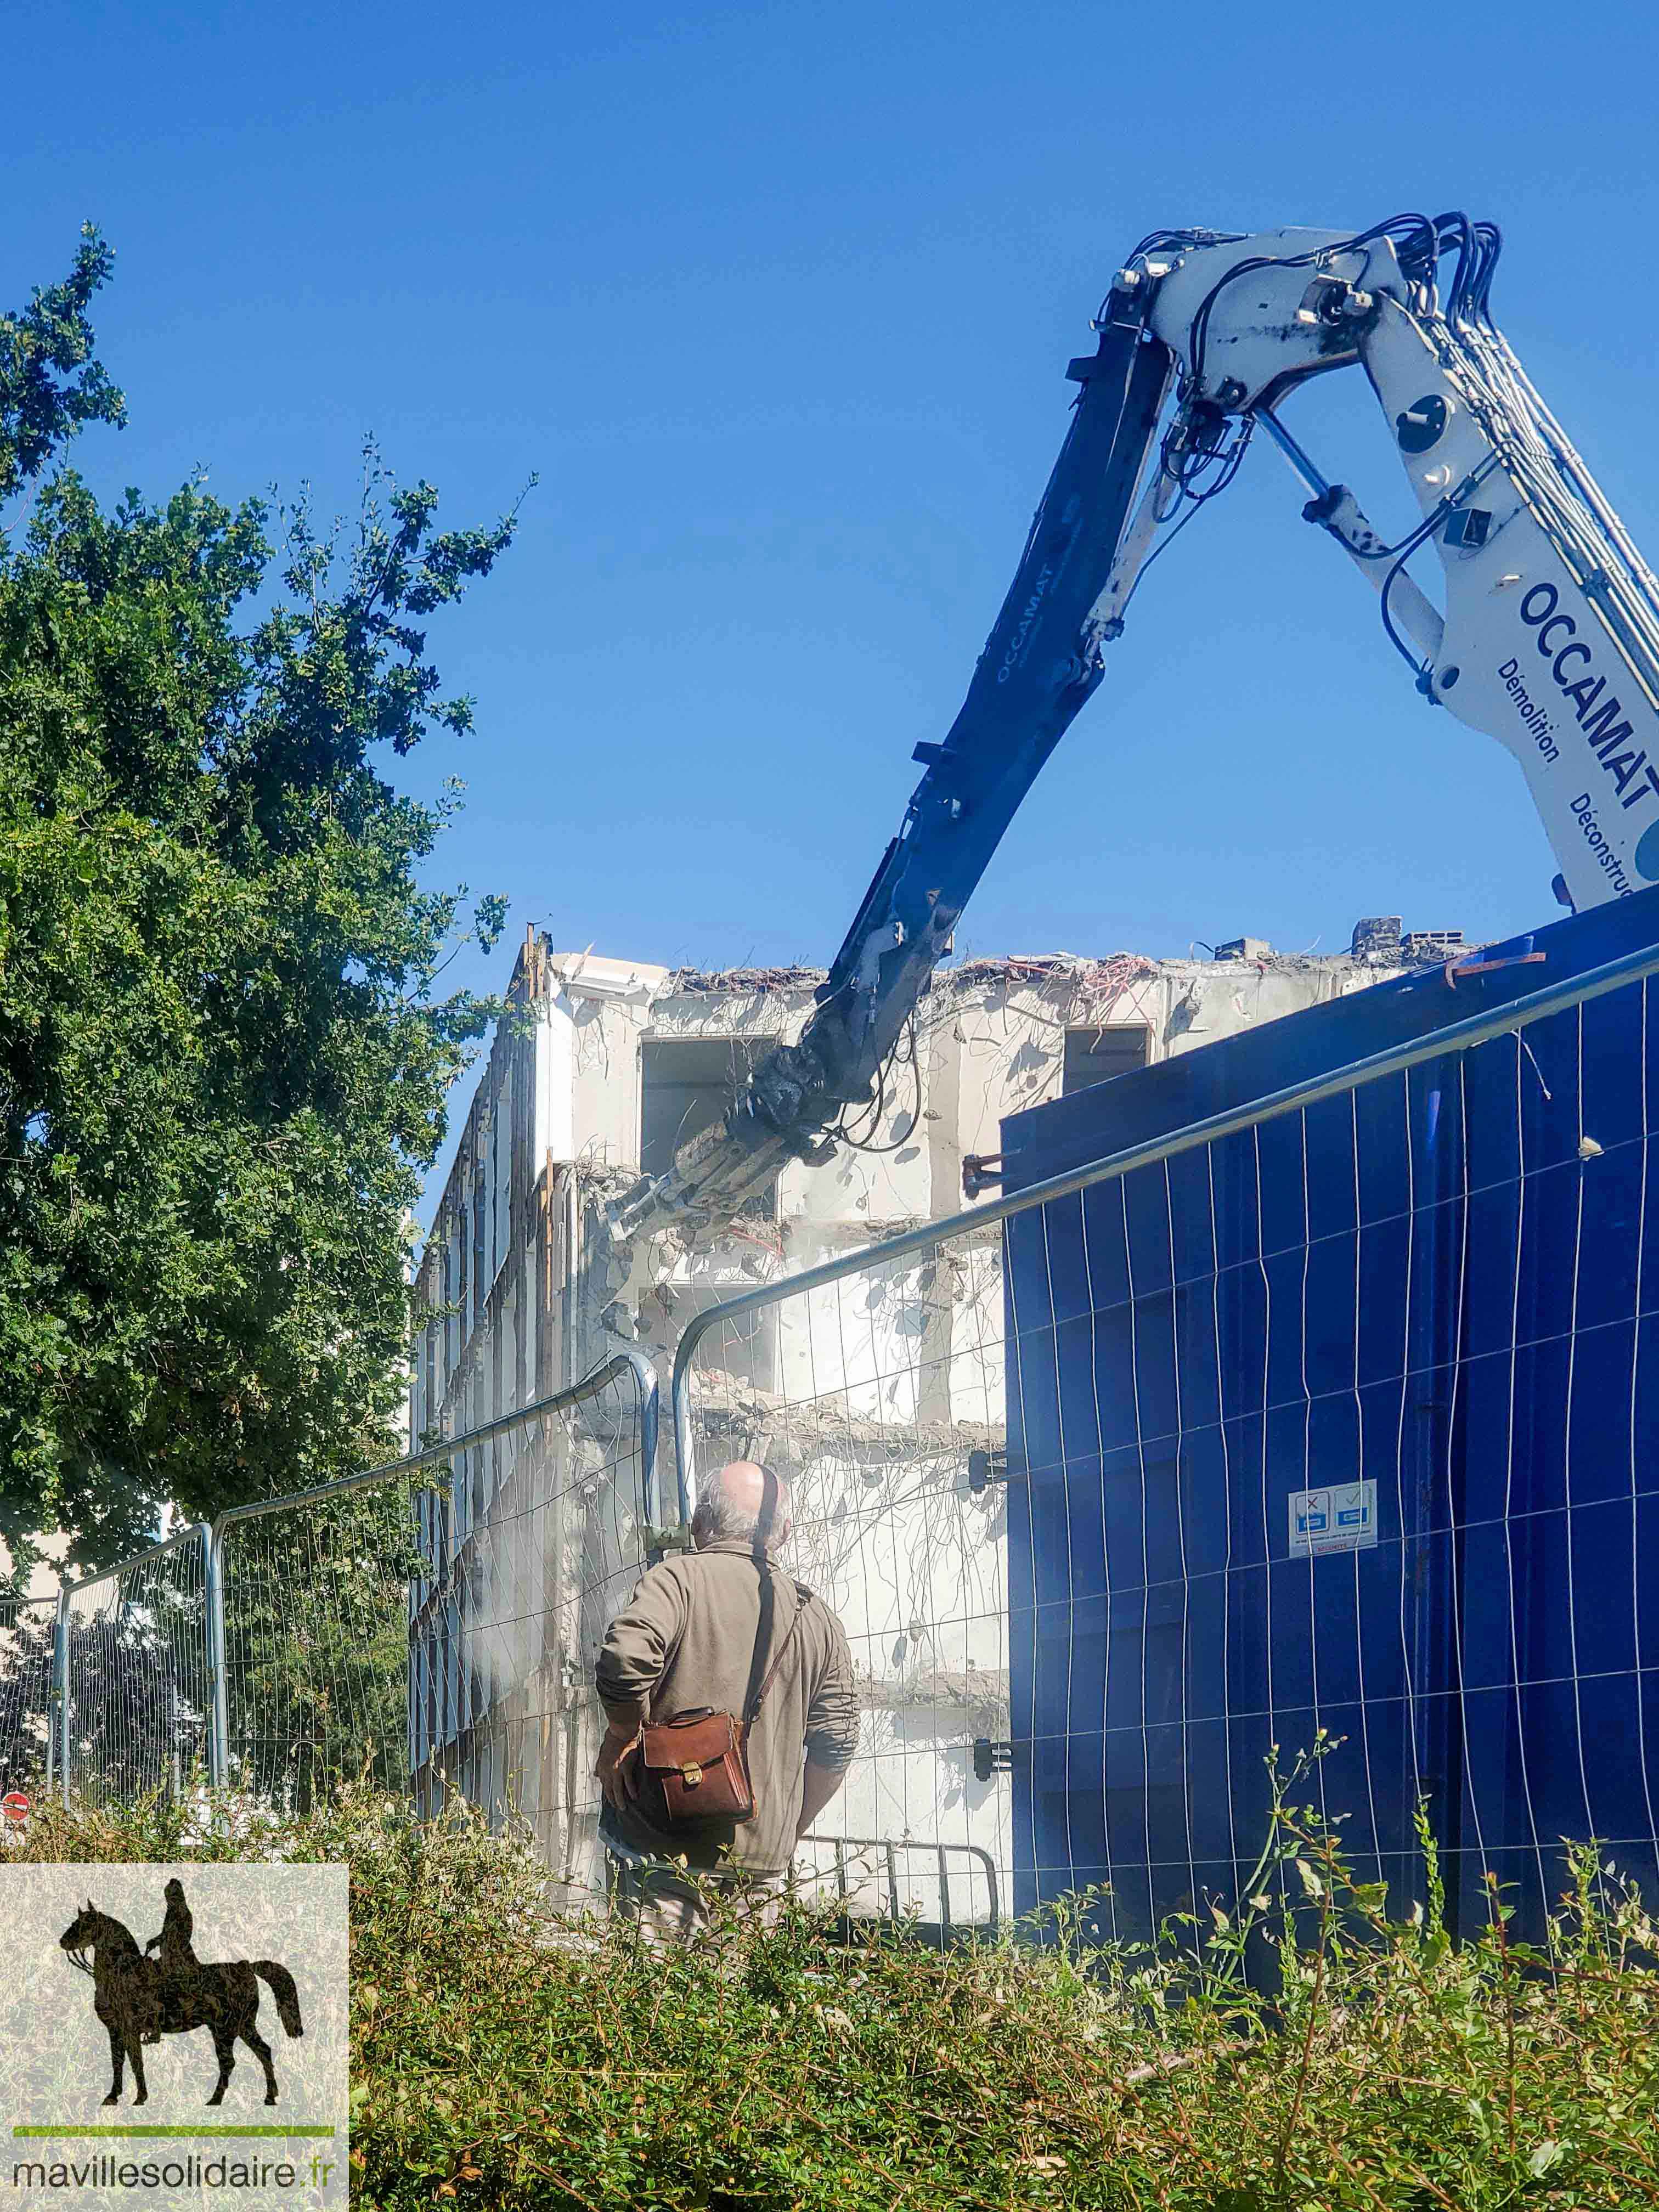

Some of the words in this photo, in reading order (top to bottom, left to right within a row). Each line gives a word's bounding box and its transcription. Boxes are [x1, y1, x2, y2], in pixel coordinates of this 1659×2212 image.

[997, 563, 1052, 682] OCCAMAT
[1498, 658, 1560, 763] Démolition
[1520, 583, 1659, 809] OCCAMAT
